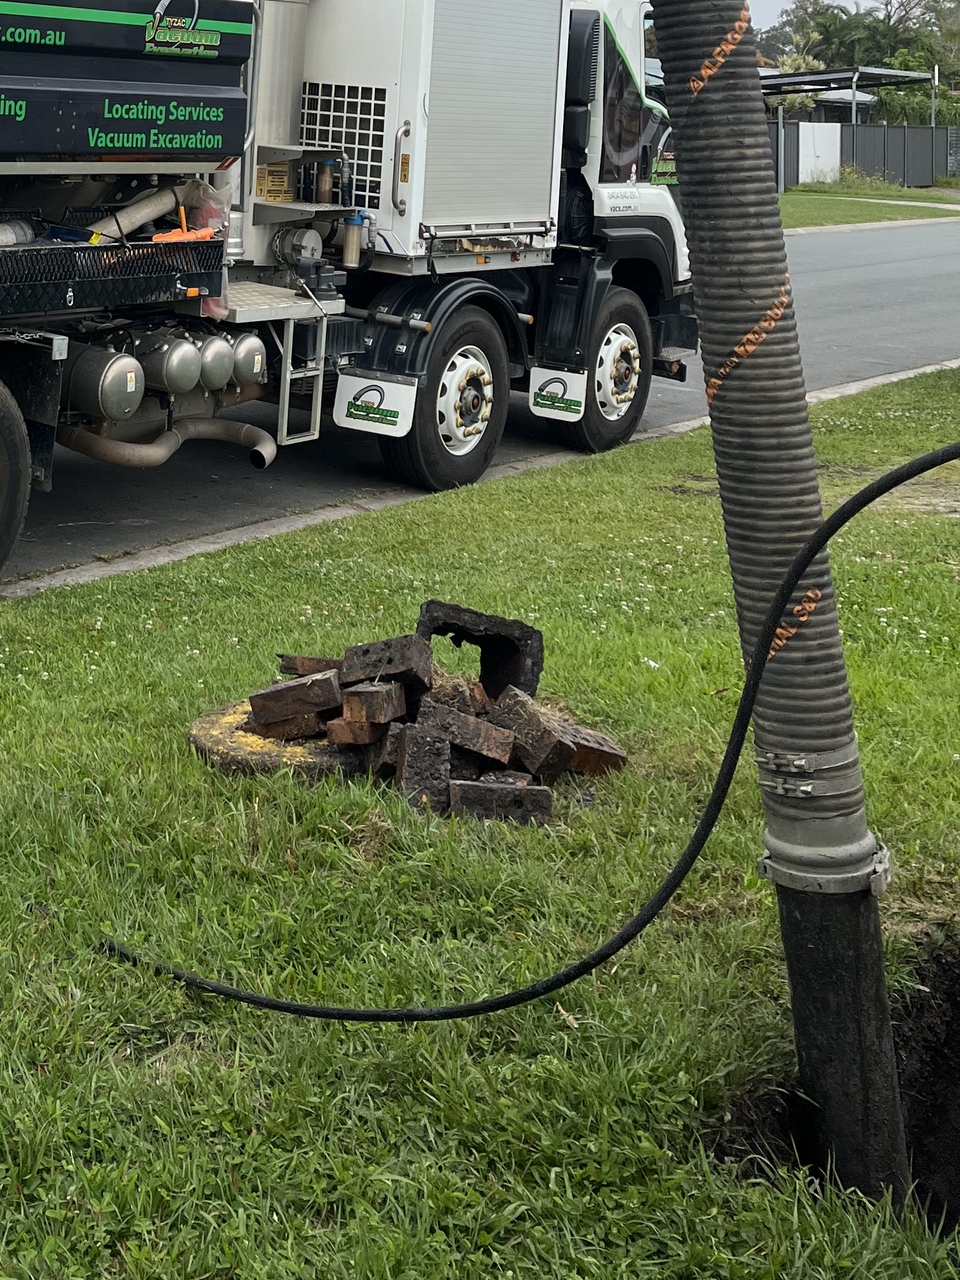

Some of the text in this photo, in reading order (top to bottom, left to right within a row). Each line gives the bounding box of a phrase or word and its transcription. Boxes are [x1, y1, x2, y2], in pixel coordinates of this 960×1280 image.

[145, 21, 221, 46] Vacuum
[165, 17, 186, 27] TYZAC
[103, 99, 224, 125] Locating Services
[87, 127, 222, 150] Vacuum Excavation
[717, 356, 739, 377] ITALY
[792, 587, 822, 622] S&D
